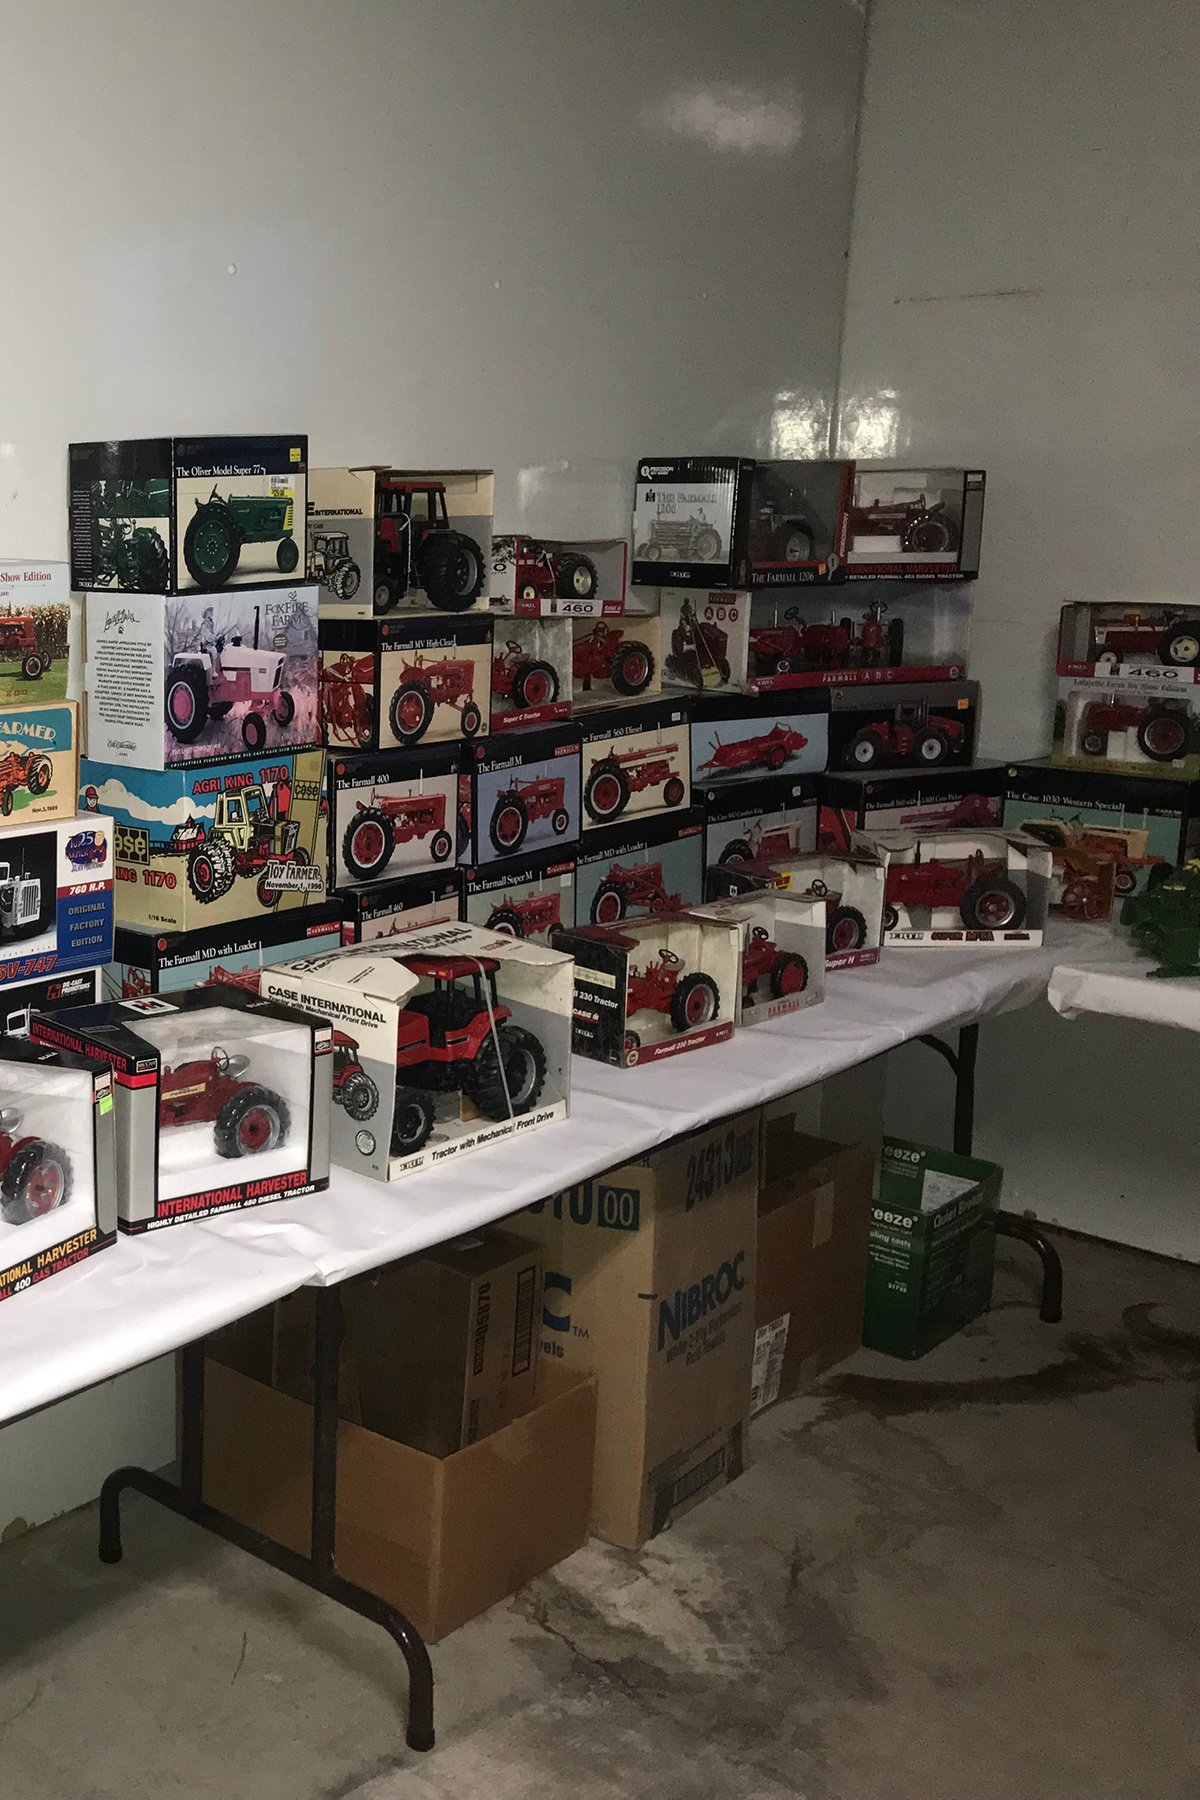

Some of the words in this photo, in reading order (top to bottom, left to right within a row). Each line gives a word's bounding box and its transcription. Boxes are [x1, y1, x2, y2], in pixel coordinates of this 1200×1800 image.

[176, 467, 190, 477] The
[191, 466, 211, 476] Oliver
[212, 465, 232, 475] Model
[233, 465, 252, 476] Super
[253, 464, 260, 474] 77
[0, 572, 21, 583] Show
[23, 571, 52, 582] Edition
[751, 572, 766, 583] THE
[767, 571, 797, 582] FARMALL
[265, 601, 310, 617] FOXFIRE
[562, 604, 593, 613] 460
[272, 612, 301, 627] FARM
[1128, 669, 1179, 678] 460
[590, 730, 612, 742] Farmall
[625, 724, 643, 735] Diesel
[477, 763, 490, 774] The
[491, 757, 515, 771] Farmall
[515, 755, 523, 765] M
[192, 778, 221, 796] AGRI
[224, 771, 254, 790] KING
[260, 765, 290, 785] 1170
[336, 779, 350, 790] The
[351, 776, 375, 787] Farmall
[376, 773, 390, 783] 400
[295, 783, 319, 799] case
[1006, 791, 1021, 800] The
[1062, 797, 1093, 808] Western
[1095, 800, 1122, 811] Special
[78, 832, 94, 846] 25
[268, 861, 286, 880] TOY
[286, 862, 321, 881] FARMER
[69, 885, 87, 896] 760
[88, 881, 106, 892] H.P.
[266, 881, 299, 892] November
[307, 882, 323, 891] 1996
[467, 882, 481, 893] The
[482, 876, 506, 890] Farmall
[507, 874, 524, 887] Super
[524, 870, 533, 881] M
[67, 901, 107, 916] ORIGINAL
[69, 918, 105, 932] FACTORY
[161, 915, 177, 925] Scale
[71, 935, 103, 948] EDITION
[158, 957, 173, 968] The
[174, 952, 200, 966] Farmall
[201, 949, 216, 961] MD
[217, 946, 233, 957] with
[233, 940, 257, 953] Loader
[268, 985, 299, 1002] CASE
[300, 993, 387, 1024] INTERNATIONAL
[579, 989, 593, 1002] 230
[593, 993, 618, 1010] Tractor
[305, 1004, 341, 1020] Mechanical
[341, 1013, 360, 1024] Front
[360, 1018, 379, 1029] Drive
[31, 1021, 84, 1054] INTERNATIONAL
[84, 1043, 128, 1072] HARVESTER
[431, 1146, 458, 1161] Tractor
[459, 1138, 475, 1151] with
[476, 1124, 515, 1145] Mechanical
[515, 1118, 536, 1132] Front
[536, 1111, 555, 1125] Drive
[157, 1187, 243, 1218] INTERNATIONAL
[246, 1171, 309, 1198] HARVESTER
[147, 1217, 174, 1230] HIGHLY
[174, 1208, 209, 1223] DETAILED
[210, 1201, 242, 1216] FARMALL
[243, 1198, 257, 1207] 450
[258, 1192, 282, 1205] DIESEL
[283, 1184, 316, 1198] TRACTOR
[37, 1229, 97, 1270] HARVESTER
[13, 1276, 32, 1293] 400
[32, 1267, 51, 1284] GAS
[50, 1247, 90, 1275] TRACTOR
[657, 1249, 746, 1352] NIBROC
